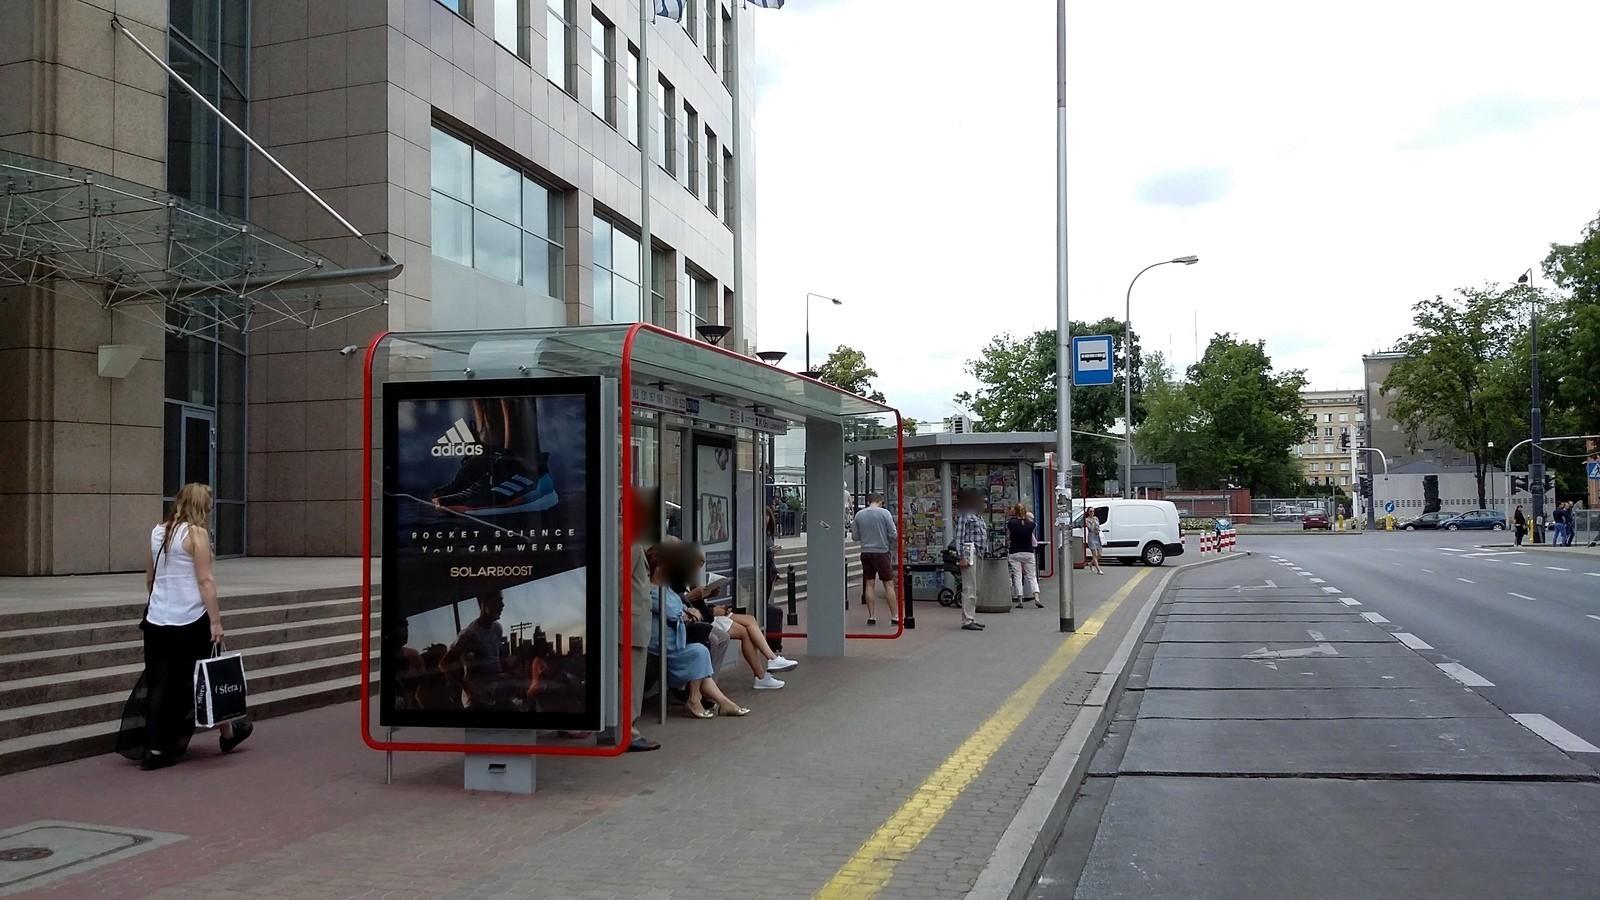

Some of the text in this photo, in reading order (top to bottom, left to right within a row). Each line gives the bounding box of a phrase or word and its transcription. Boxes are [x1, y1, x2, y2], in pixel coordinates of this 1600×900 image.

[431, 442, 484, 457] adidas
[411, 528, 575, 540] ROCKET SCIENCE
[468, 544, 502, 553] CAN
[516, 543, 563, 552] WEAR
[450, 565, 534, 577] SOLARBOOST
